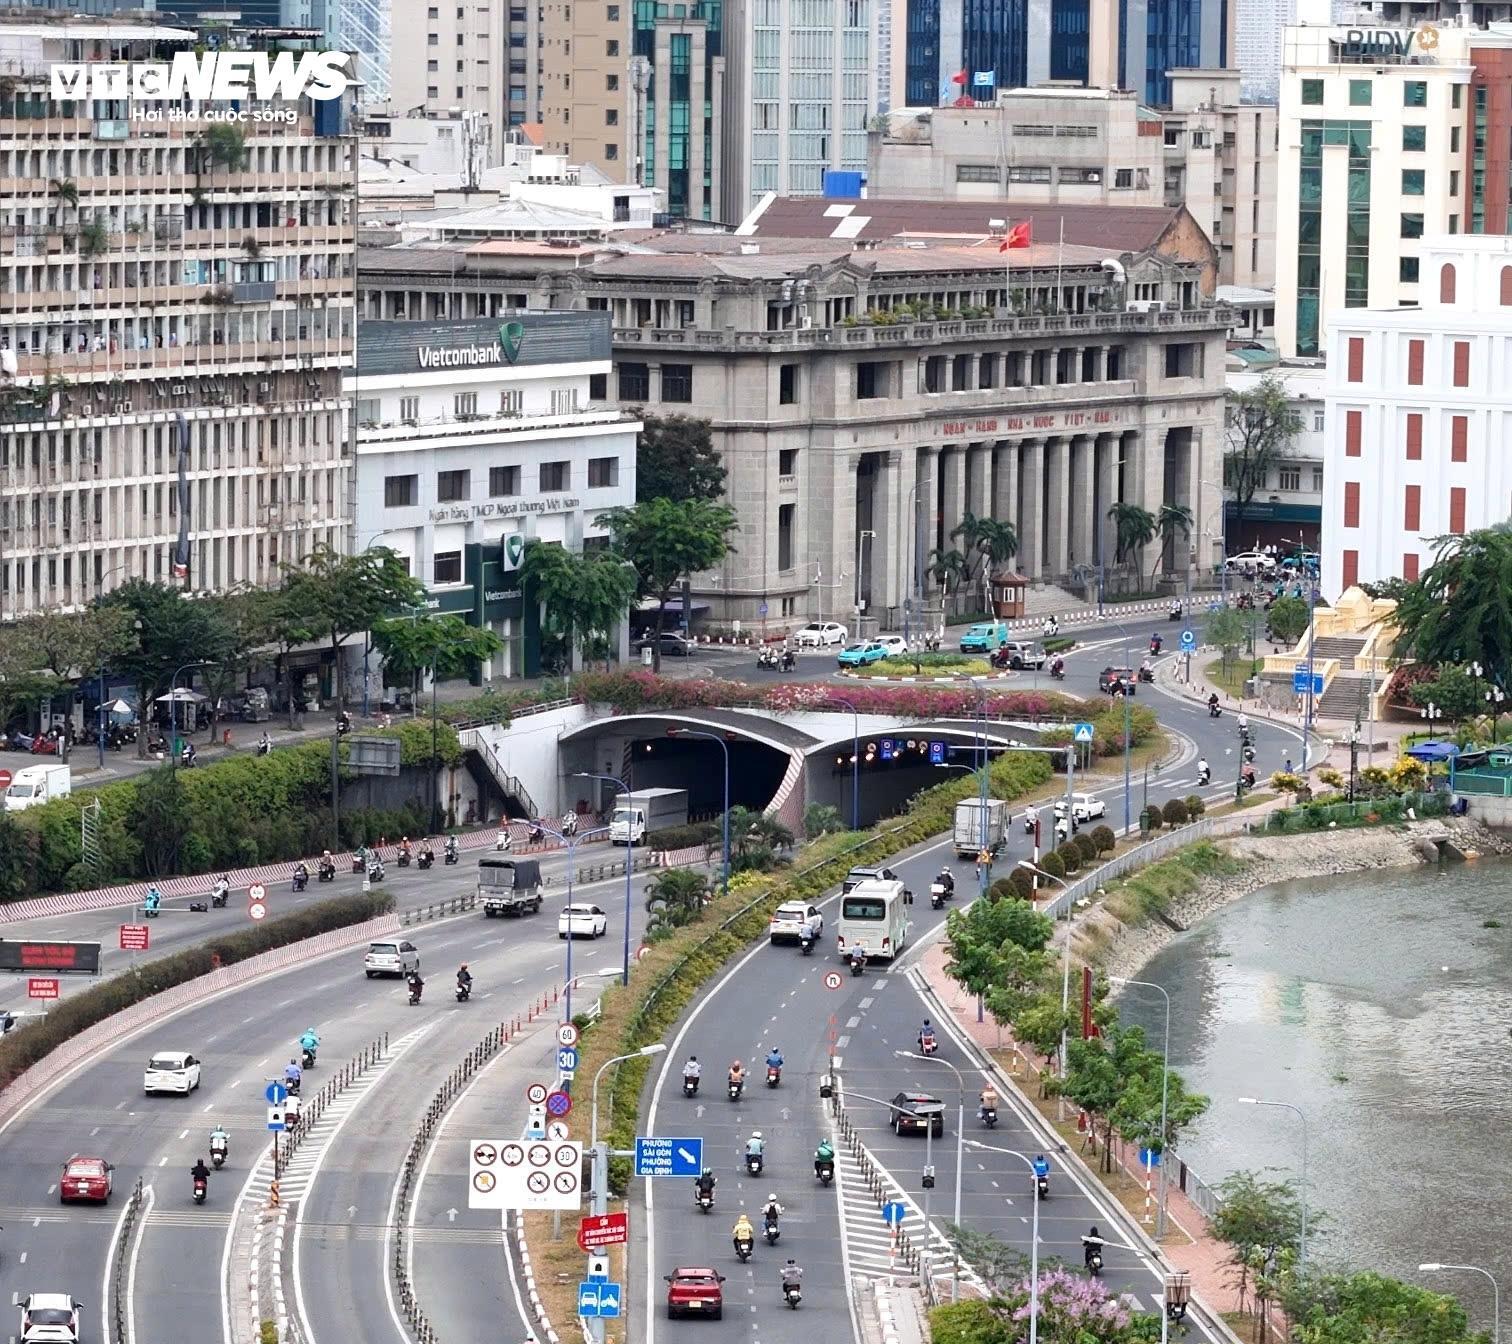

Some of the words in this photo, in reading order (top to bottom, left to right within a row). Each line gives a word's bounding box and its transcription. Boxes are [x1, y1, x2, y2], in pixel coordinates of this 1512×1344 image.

[1346, 29, 1416, 57] BIDV
[418, 341, 502, 368] Vietcombank
[562, 1029, 572, 1040] 60
[560, 1051, 575, 1069] 30
